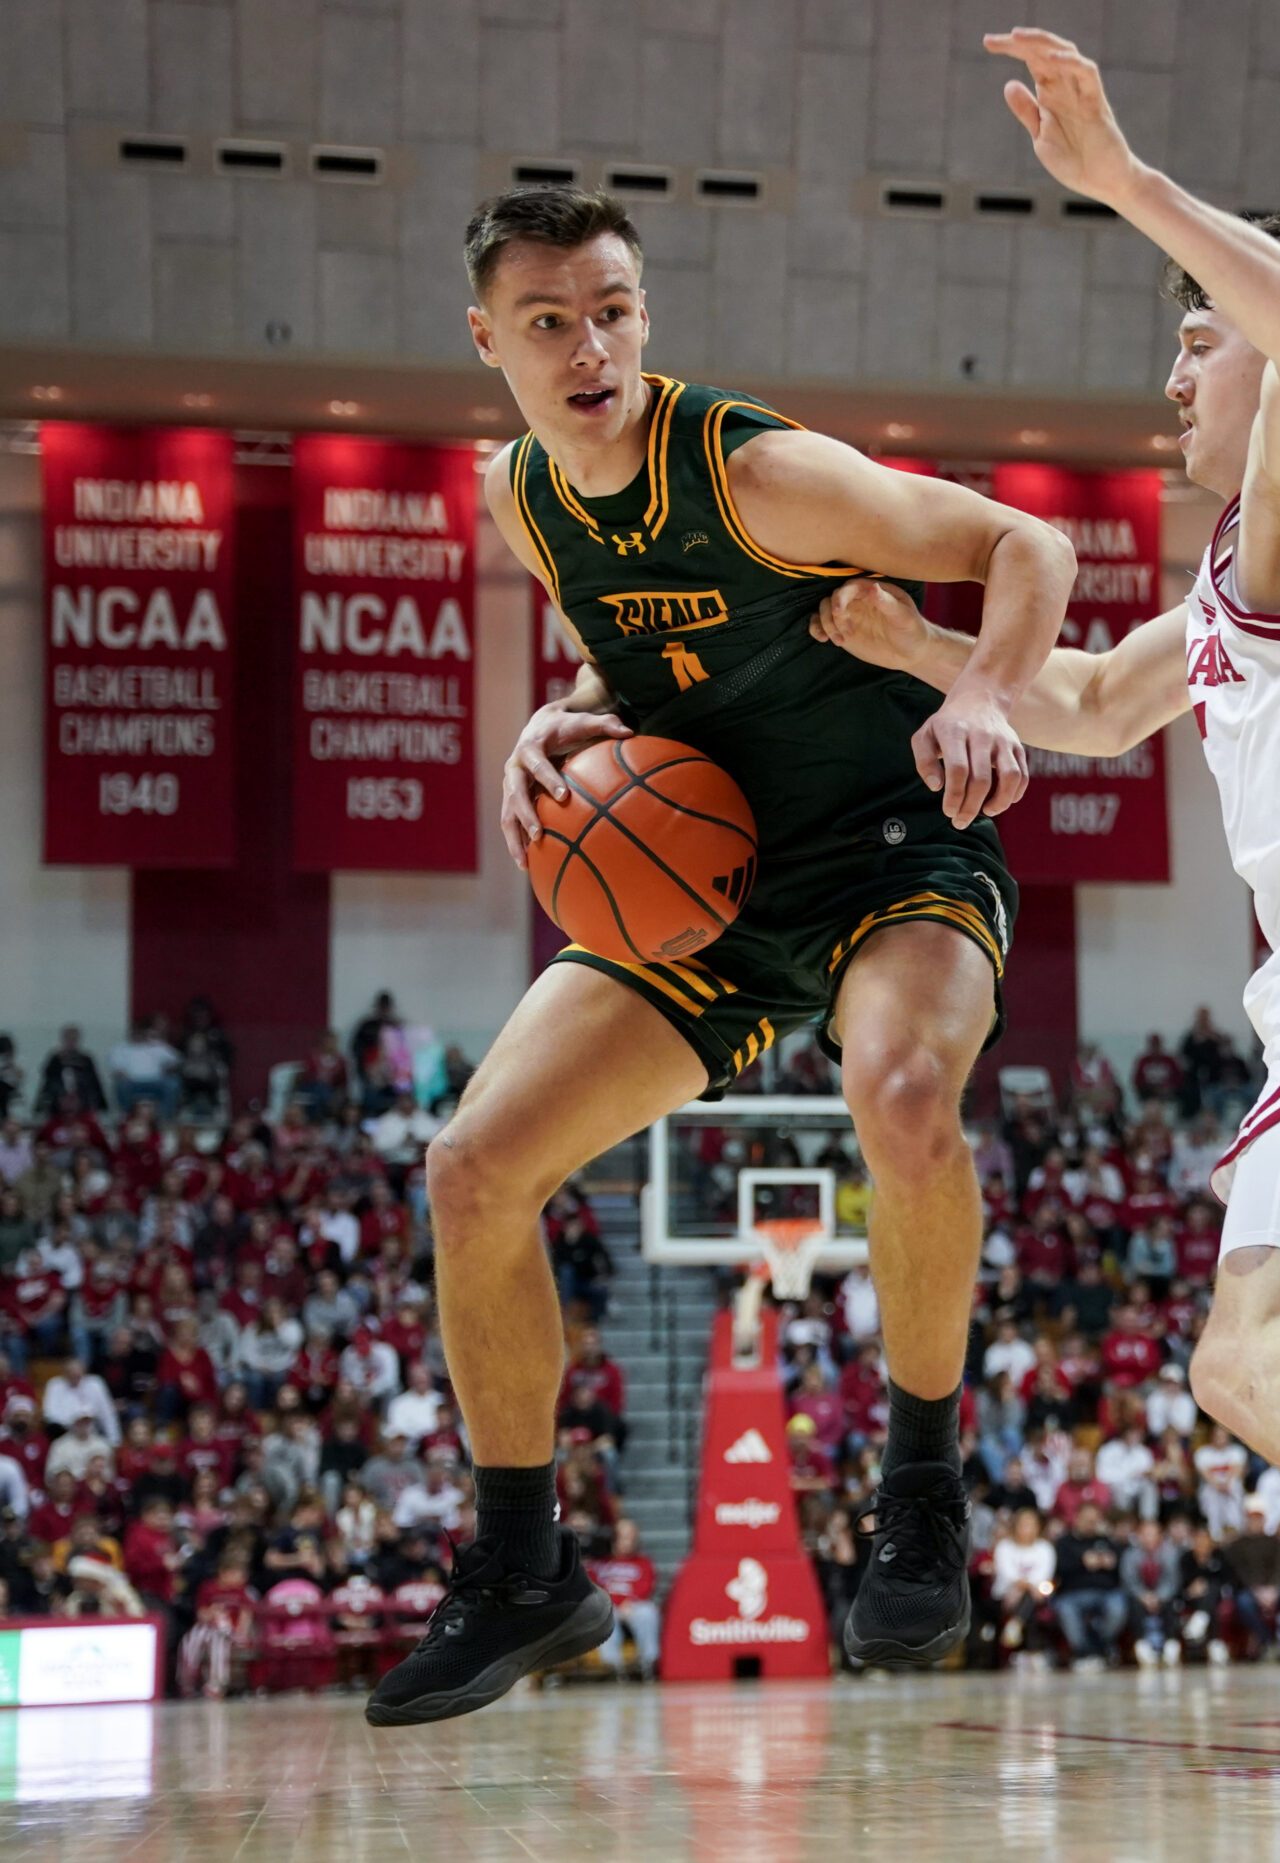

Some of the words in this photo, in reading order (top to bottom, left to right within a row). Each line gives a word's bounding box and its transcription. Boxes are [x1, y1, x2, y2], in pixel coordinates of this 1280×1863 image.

[75, 477, 204, 524] INDIANA
[324, 487, 449, 534] INDIANA
[54, 525, 223, 572] UNIVERSITY
[304, 532, 465, 582] UNIVERSITY
[53, 584, 227, 650] NCAA
[301, 591, 472, 662] NCAA
[54, 664, 222, 710] BASKETBALL
[303, 669, 467, 718] BASKETBALL
[59, 712, 215, 757] CHAMPIONS
[310, 717, 461, 765] CHAMPIONS
[99, 772, 180, 815] 1940
[346, 776, 424, 821] 1953
[1049, 792, 1121, 836] 1987
[689, 1615, 810, 1646] Smithville
